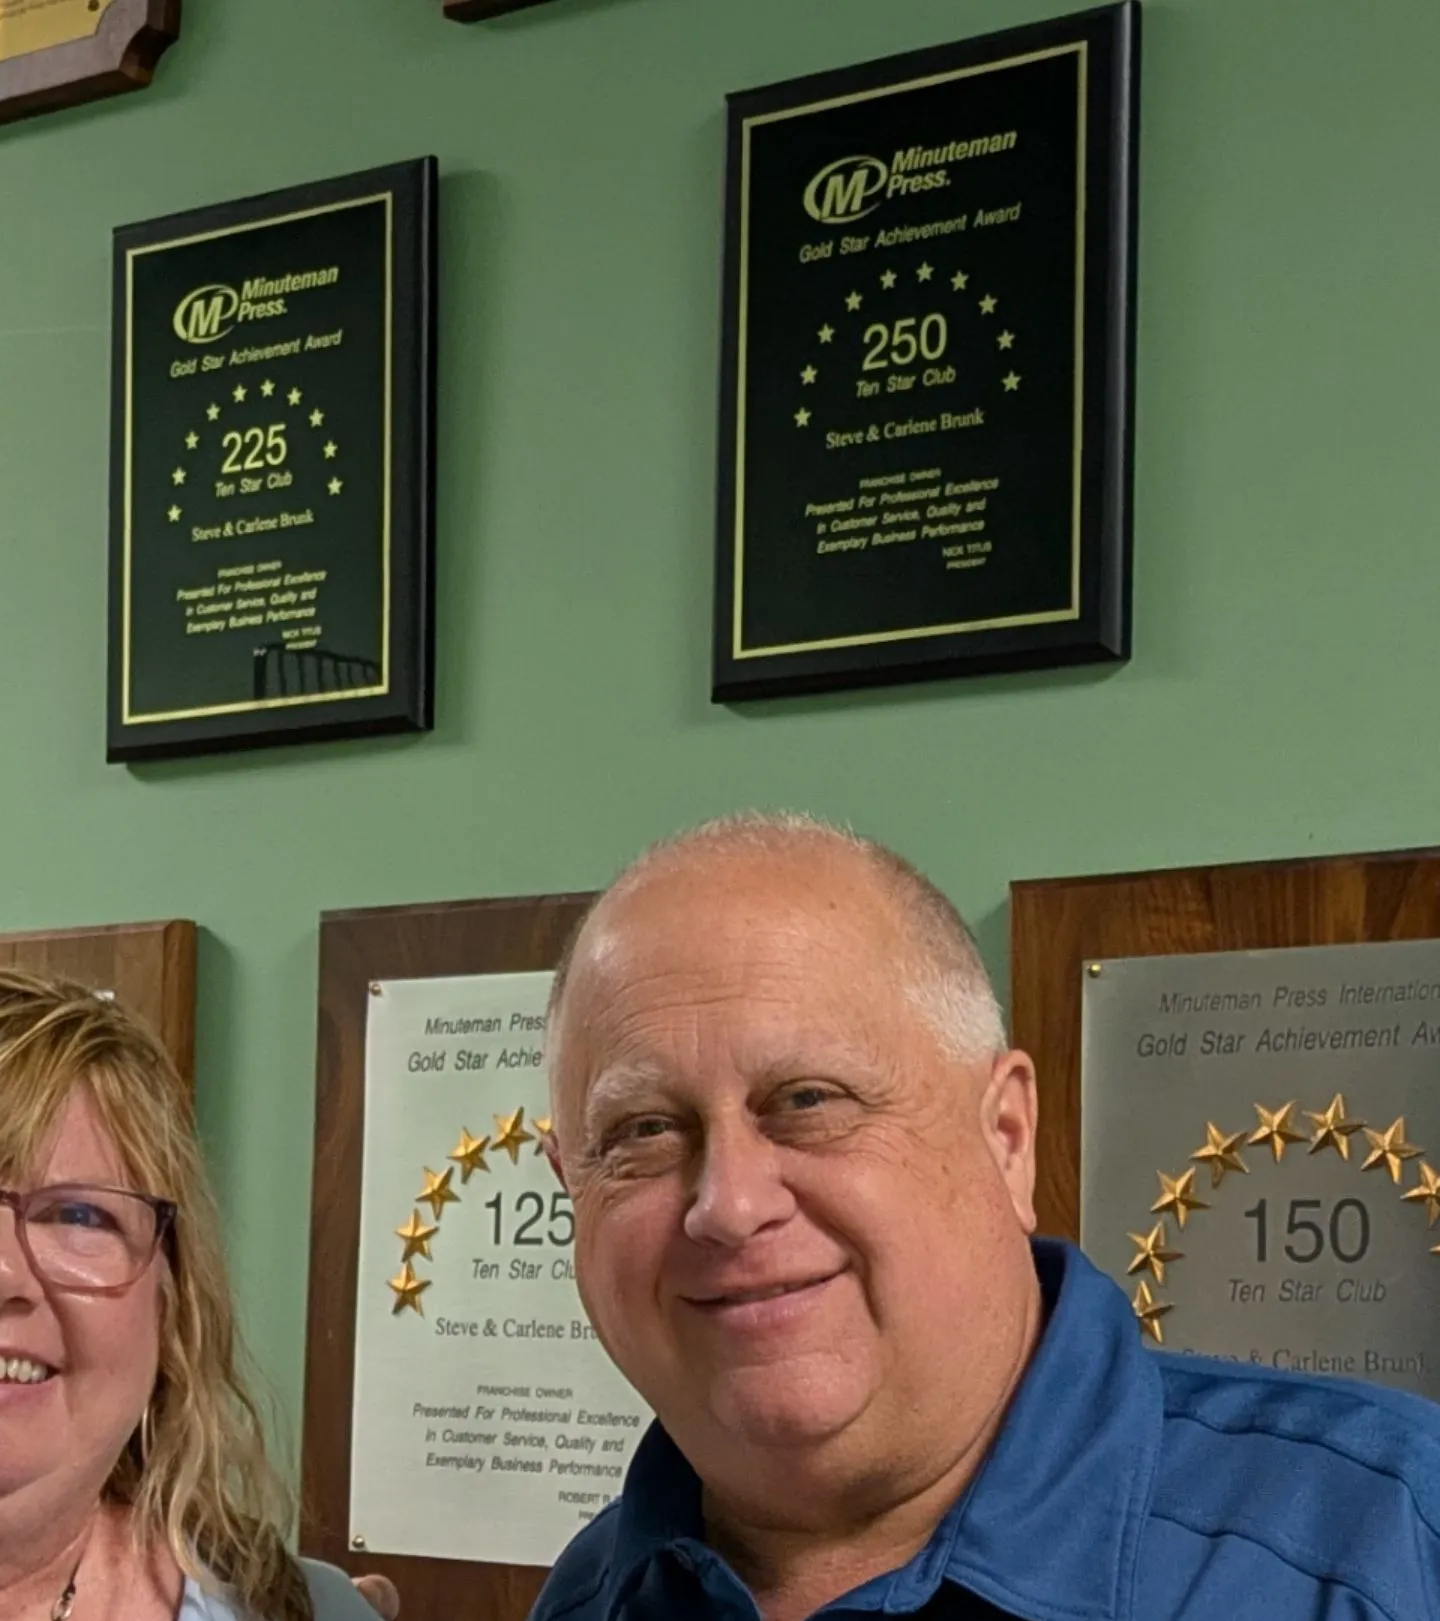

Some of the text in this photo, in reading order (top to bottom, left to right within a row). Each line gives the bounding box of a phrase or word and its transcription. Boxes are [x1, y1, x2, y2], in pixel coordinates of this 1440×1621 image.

[891, 130, 1017, 173] Minuteman
[799, 203, 1021, 265] Gold Star Achievement Award
[241, 265, 339, 300] Minuteman
[169, 328, 343, 378] Gold Star Achievement Award
[861, 312, 949, 372] 250
[856, 366, 956, 400] Ten Star Club
[826, 407, 985, 449] Steve & Carlene Brunk
[221, 424, 287, 474] 225
[215, 471, 292, 498] Ten Star Club
[1159, 988, 1262, 1015] Minuteman
[1271, 985, 1328, 1010] Press
[424, 1014, 502, 1036] Minuteman
[1137, 1031, 1188, 1059] Gold
[1199, 1030, 1247, 1056] Star
[1255, 1022, 1401, 1054] Achievement
[408, 1052, 445, 1073] Gold
[454, 1051, 489, 1071] Star
[485, 1191, 575, 1248] 125
[1244, 1197, 1372, 1264] 150
[472, 1259, 542, 1279] Ten Star
[1227, 1278, 1388, 1304] Ten Star Club
[435, 1317, 478, 1337] Steve
[483, 1318, 497, 1337] &
[502, 1319, 565, 1339] Carlene
[412, 1403, 640, 1428] Presented For Professional Excellence
[442, 1429, 498, 1445] Customer
[555, 1434, 596, 1454] Quality
[601, 1438, 625, 1452] and
[426, 1452, 623, 1478] Exemplary Business Performance
